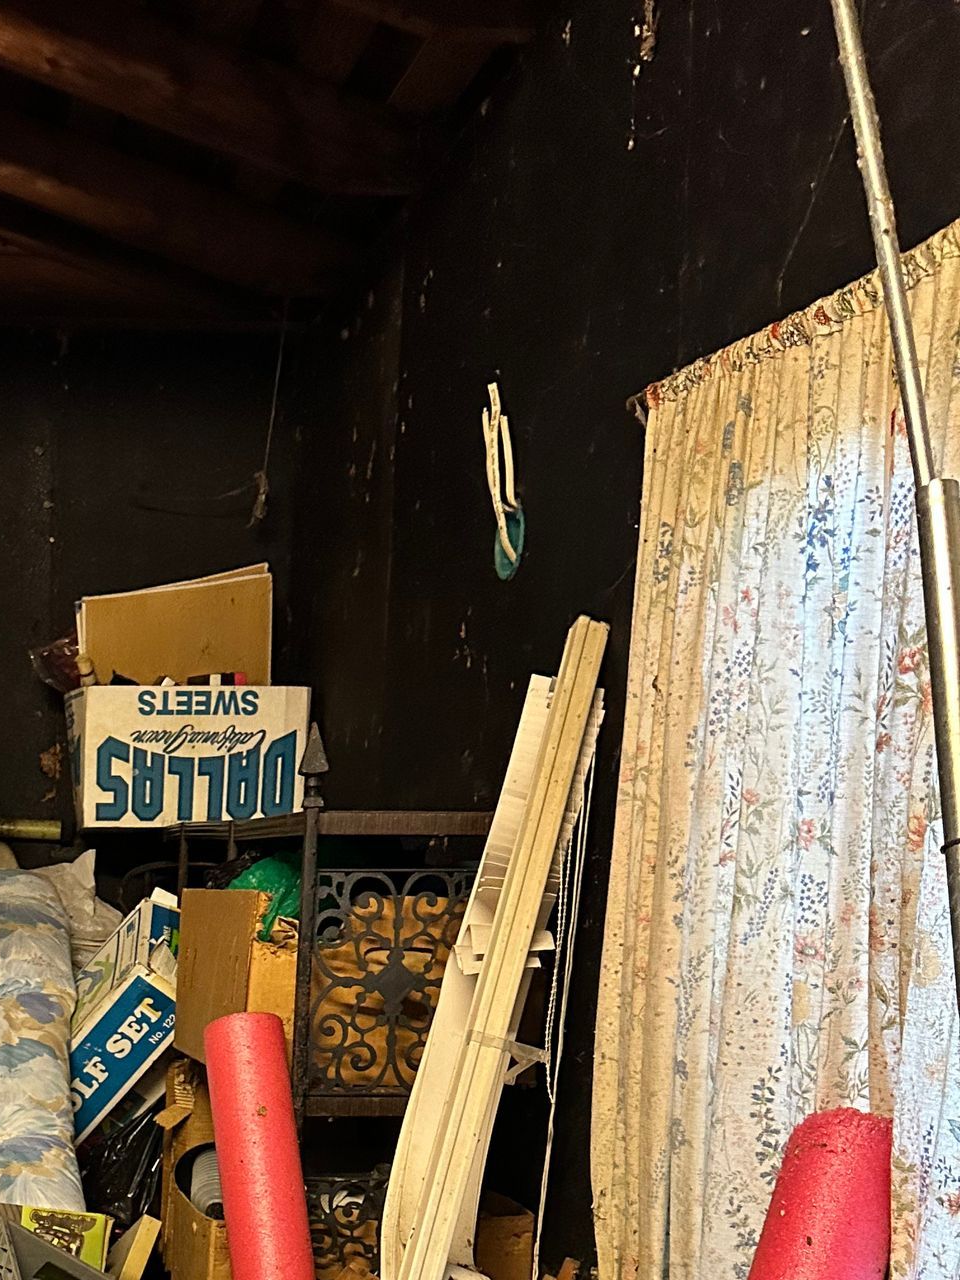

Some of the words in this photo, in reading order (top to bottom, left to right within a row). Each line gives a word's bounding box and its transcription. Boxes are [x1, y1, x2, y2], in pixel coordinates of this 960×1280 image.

[138, 690, 259, 716] SWEETS
[96, 729, 297, 821] DALLAS
[73, 1057, 109, 1113] OLF
[105, 997, 162, 1060] SET
[148, 1029, 166, 1044] No.
